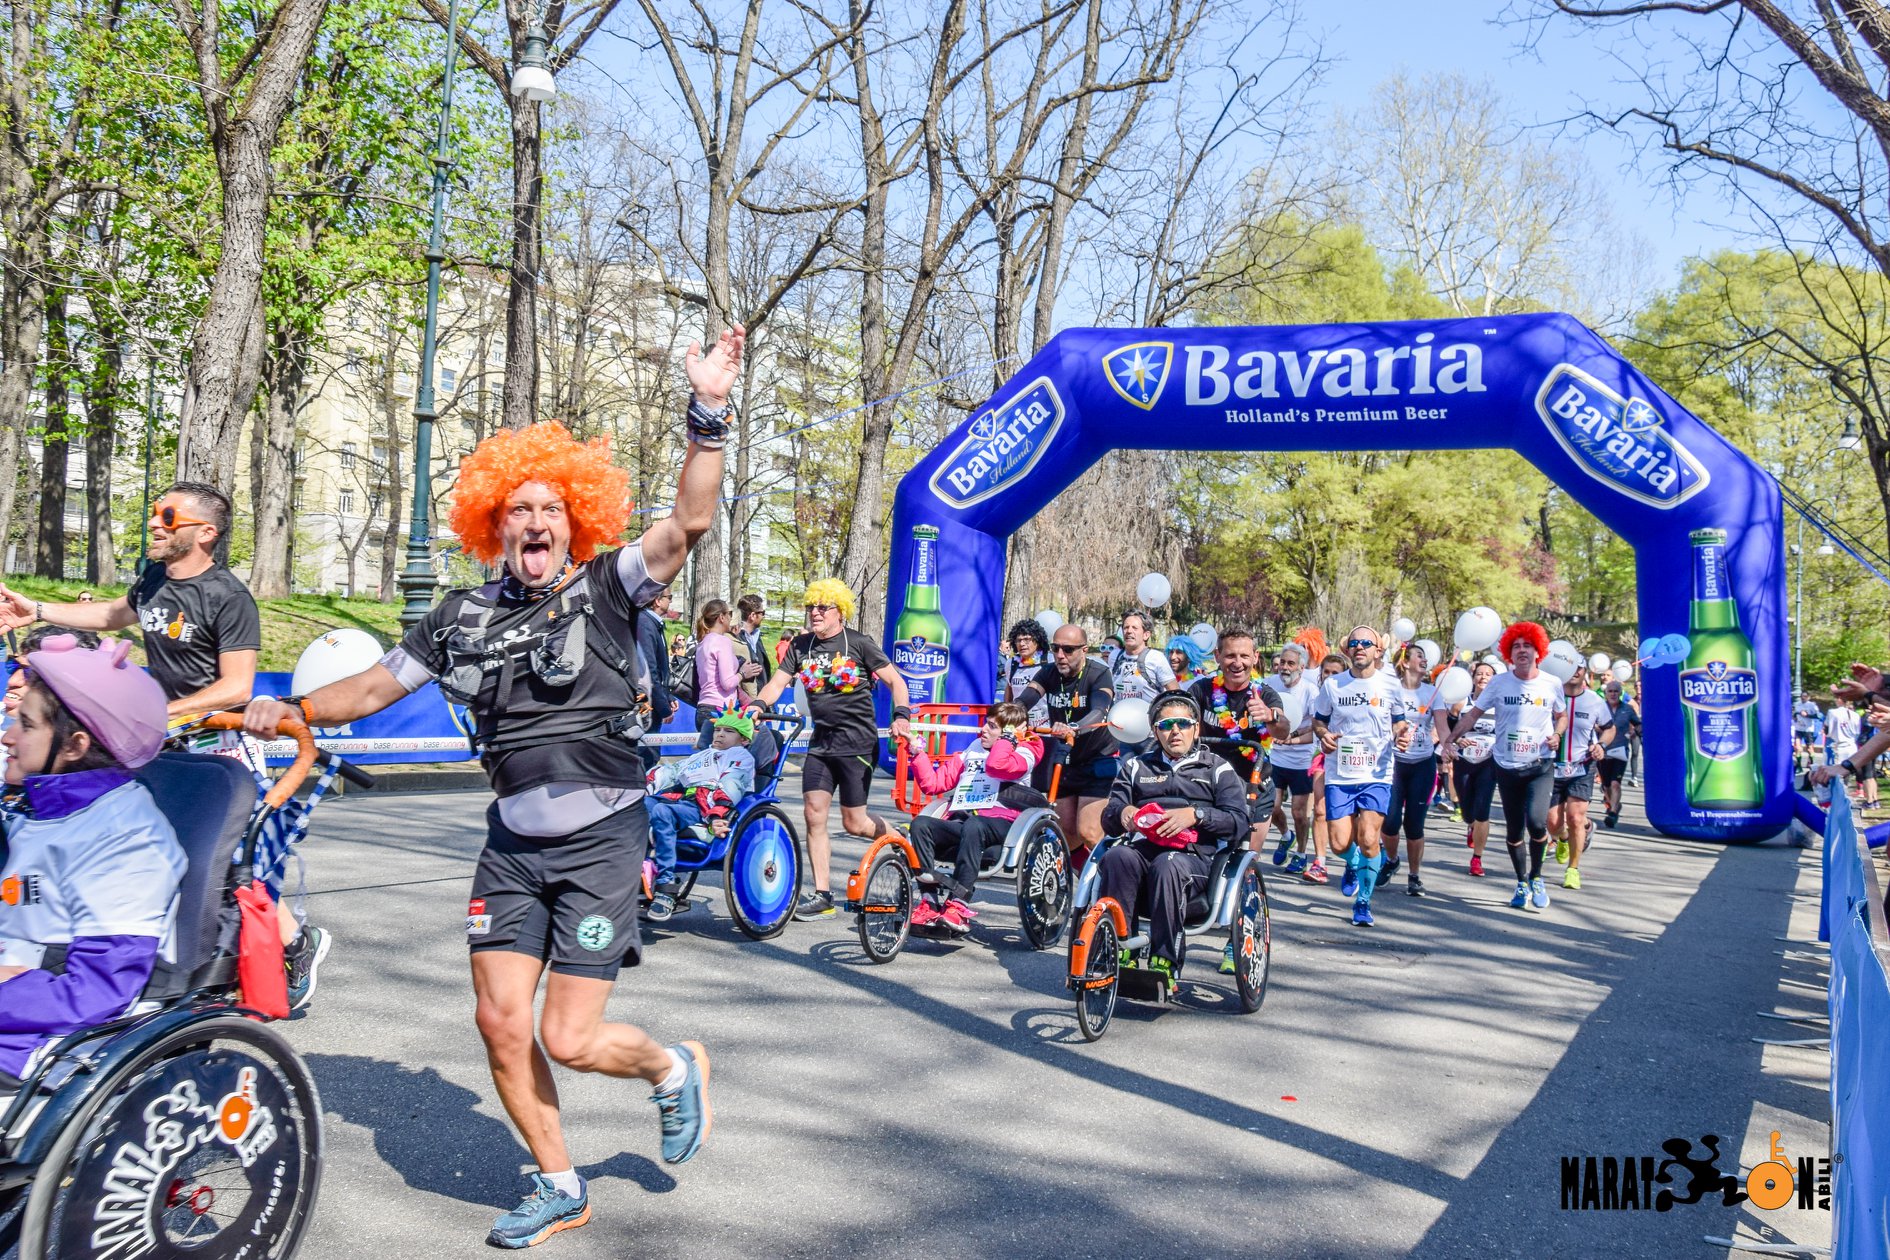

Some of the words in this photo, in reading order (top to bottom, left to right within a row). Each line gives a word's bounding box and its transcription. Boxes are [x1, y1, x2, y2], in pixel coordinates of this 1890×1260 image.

[1184, 332, 1487, 406] Bavaria
[1225, 408, 1310, 423] Holland's
[1315, 406, 1399, 422] Premium
[1405, 406, 1448, 420] Beer
[946, 400, 1051, 496] Bavaria
[1551, 383, 1677, 494] Bavaria
[917, 540, 929, 582] Bavaria
[1701, 547, 1719, 597] Bavaria
[895, 648, 946, 667] Bavaria
[1683, 676, 1754, 697] Bavaria
